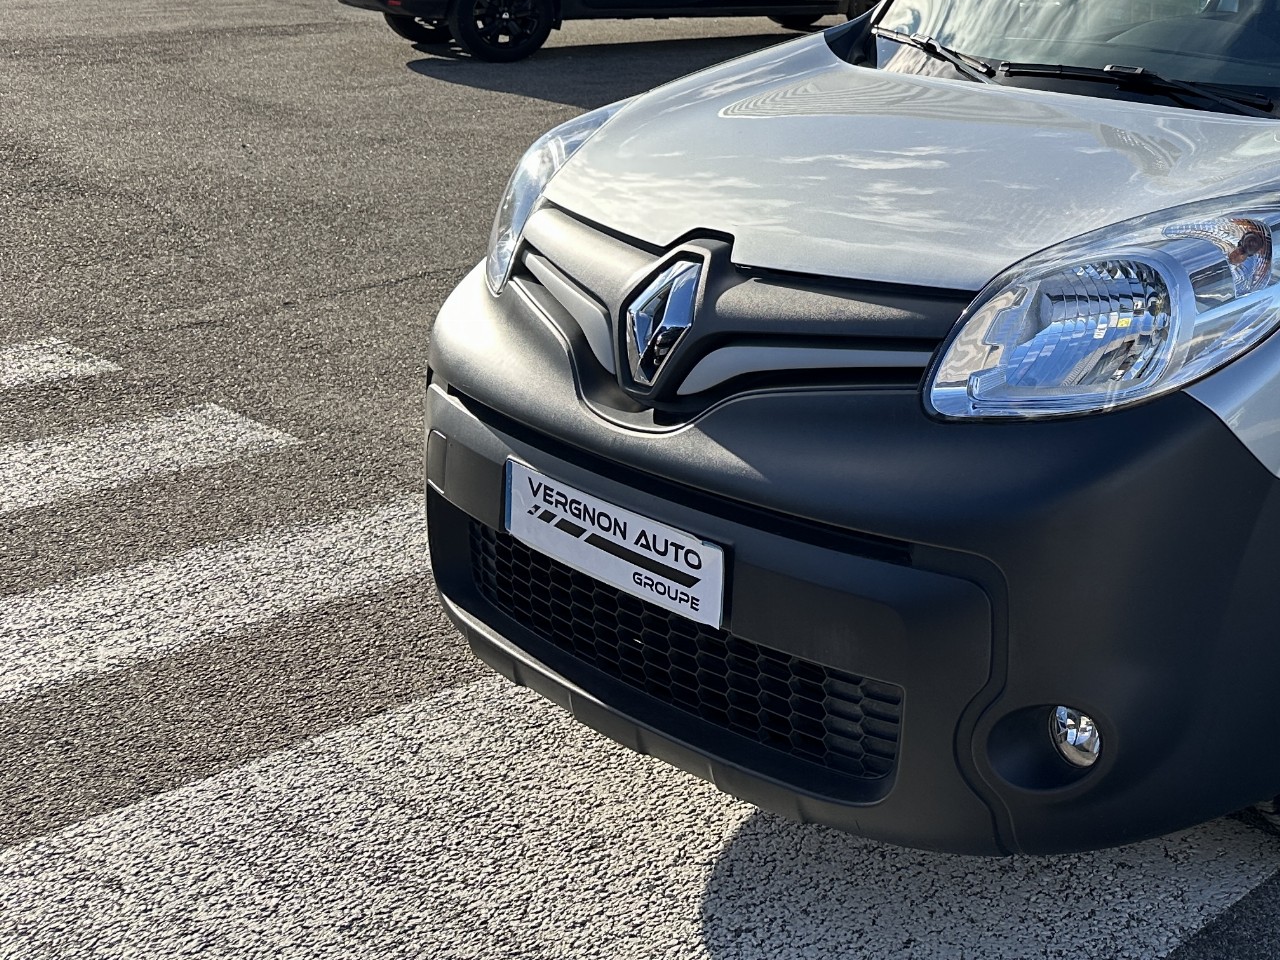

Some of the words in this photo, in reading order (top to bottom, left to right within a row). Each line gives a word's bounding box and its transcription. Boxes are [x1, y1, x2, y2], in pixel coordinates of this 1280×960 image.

[527, 477, 628, 541] VERGNON
[633, 529, 703, 570] AUTO
[632, 572, 700, 612] GROUPE
